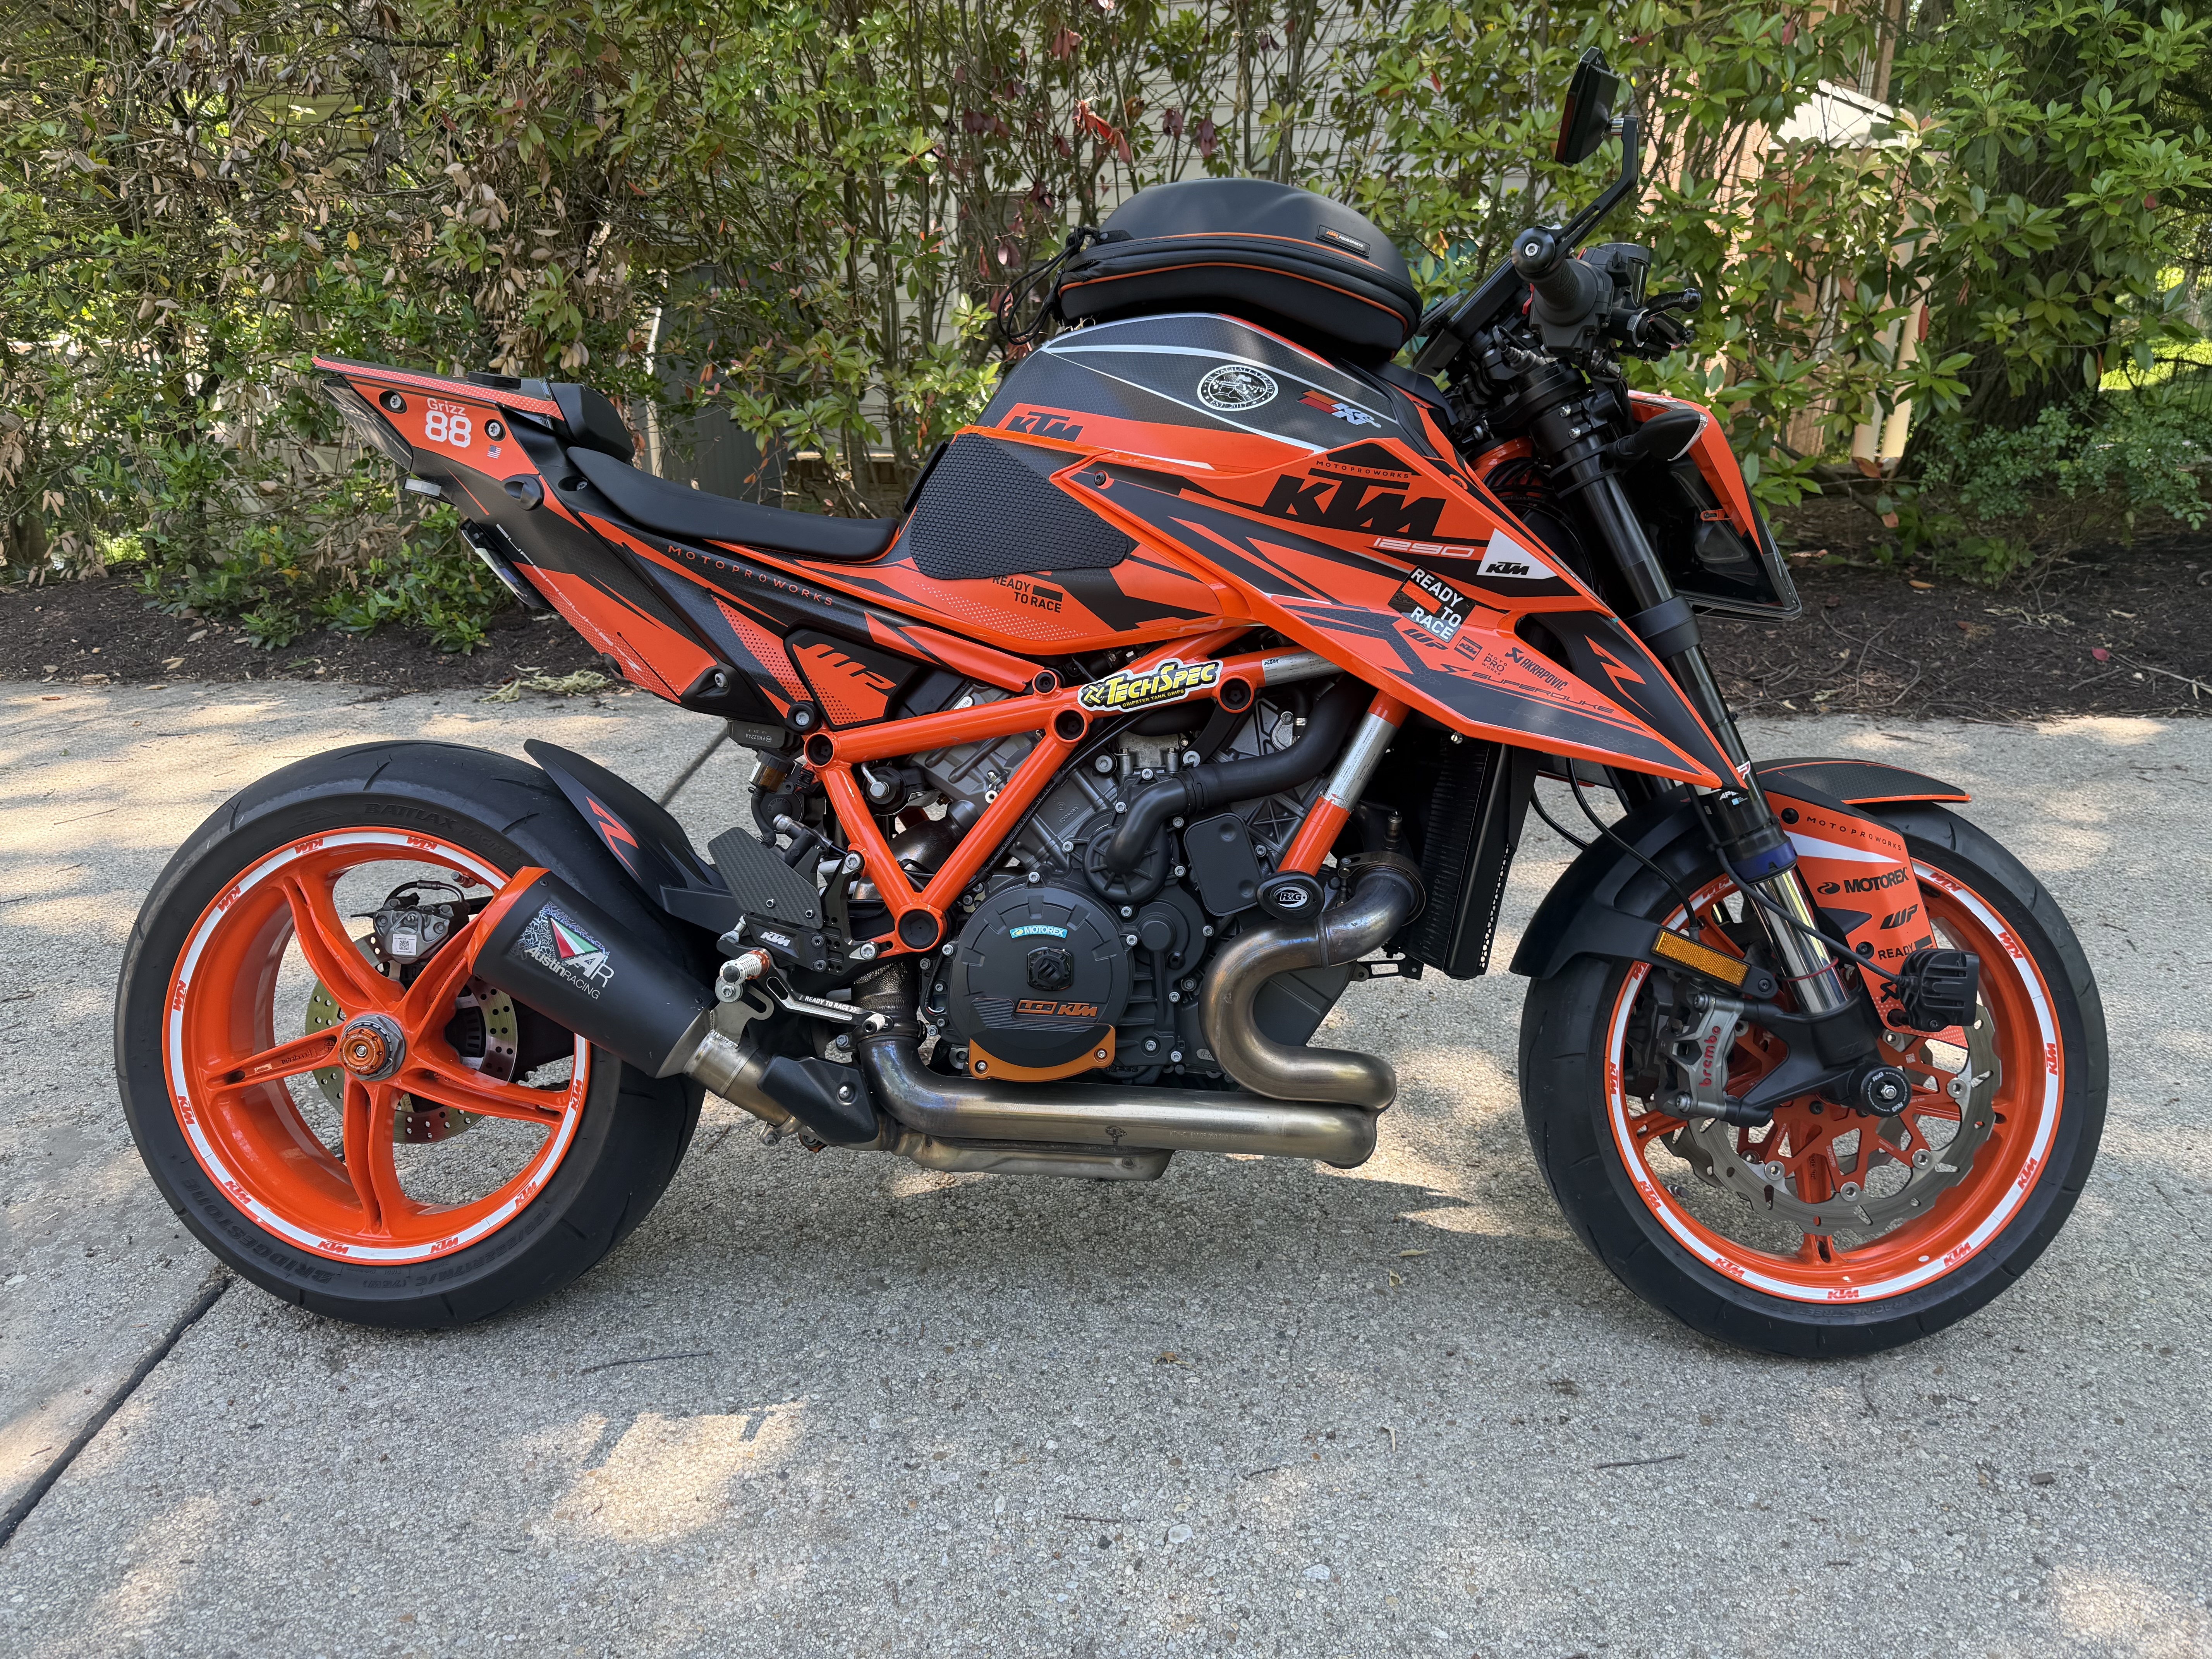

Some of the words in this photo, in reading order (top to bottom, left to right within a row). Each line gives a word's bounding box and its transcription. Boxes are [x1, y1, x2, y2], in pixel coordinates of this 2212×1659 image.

[427, 397, 466, 416] Grizz
[425, 410, 472, 448] 88
[1005, 411, 1084, 442] KTM
[1262, 467, 1447, 538] KTM
[1374, 538, 1475, 558] 1290
[1485, 561, 1530, 576] KTM
[992, 575, 1031, 593] READY
[1410, 568, 1463, 608] READY
[1014, 591, 1029, 605] TO
[1030, 598, 1062, 613] RACE
[1410, 606, 1453, 641] RACE
[1440, 606, 1462, 628] TO
[1459, 642, 1477, 655] KTM
[1487, 653, 1508, 666] MOTO
[1482, 661, 1501, 676] WORKS
[1483, 656, 1505, 673] PRO
[1122, 697, 1150, 708] GRIPSTER
[1150, 693, 1166, 701] TANK
[1167, 689, 1184, 697] GRIPS
[1471, 671, 1614, 714] SUPERDUKE
[363, 802, 459, 830] BATTLAX
[294, 838, 324, 854] KTM
[405, 836, 438, 851] KTM
[1843, 869, 1908, 894] MOTOREX
[217, 884, 242, 912] KTM
[1279, 891, 1302, 902] R&G
[760, 931, 791, 947] KTM
[1024, 925, 1065, 937] MOTOREX
[1877, 944, 1913, 960] READY
[1997, 931, 2024, 960] KTM
[173, 979, 187, 1012] KTM
[805, 995, 824, 1005] READY
[833, 1001, 850, 1011] RACE
[1057, 1001, 1097, 1017] KTM
[1698, 1025, 1721, 1087] brembo
[2045, 1042, 2058, 1076] KTM
[1609, 1061, 1619, 1095] KTM
[570, 1079, 583, 1112] KTM
[177, 1095, 195, 1125] KTM
[2016, 1156, 2039, 1190] KTM
[225, 1180, 252, 1205] KTM
[514, 1180, 537, 1209] KTM
[1638, 1180, 1662, 1209] KTM
[182, 1176, 336, 1284] BRIDGESTONE
[317, 1240, 349, 1255] KTM
[429, 1237, 460, 1254] KTM
[1943, 1242, 1972, 1268] KTM
[1714, 1257, 1745, 1278] KTM
[1827, 1288, 1859, 1300] KTM
